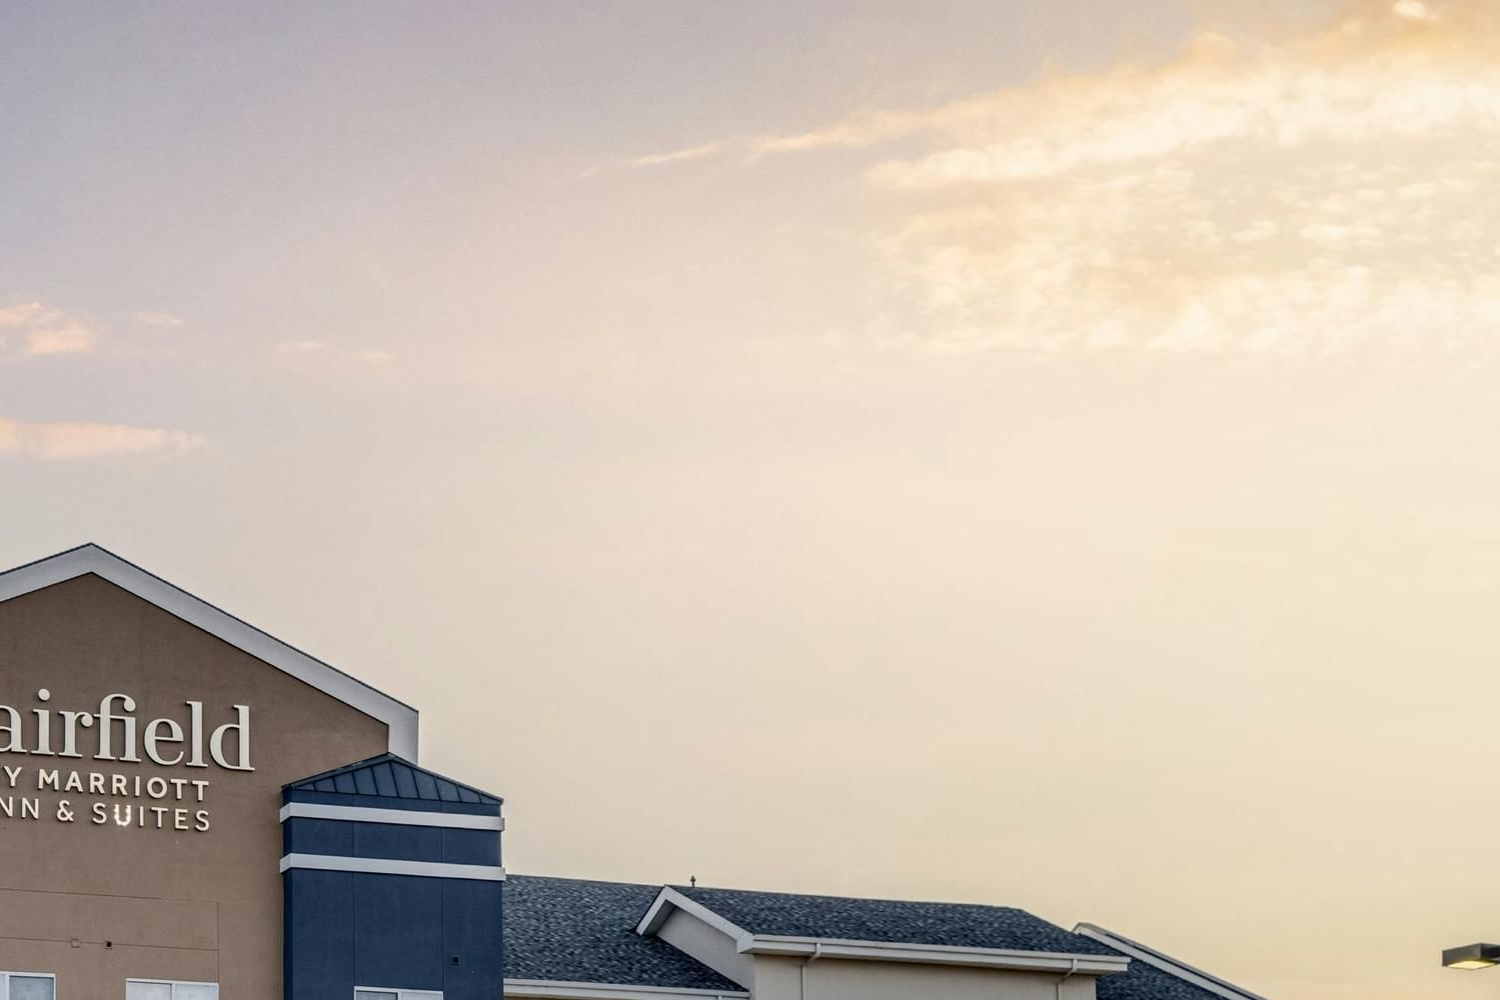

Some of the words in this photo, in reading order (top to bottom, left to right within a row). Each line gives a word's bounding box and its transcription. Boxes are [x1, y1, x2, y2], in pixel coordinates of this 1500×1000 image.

[38, 768, 210, 802] MARRIOTT
[56, 800, 74, 823] &
[92, 802, 211, 832] SUITES
